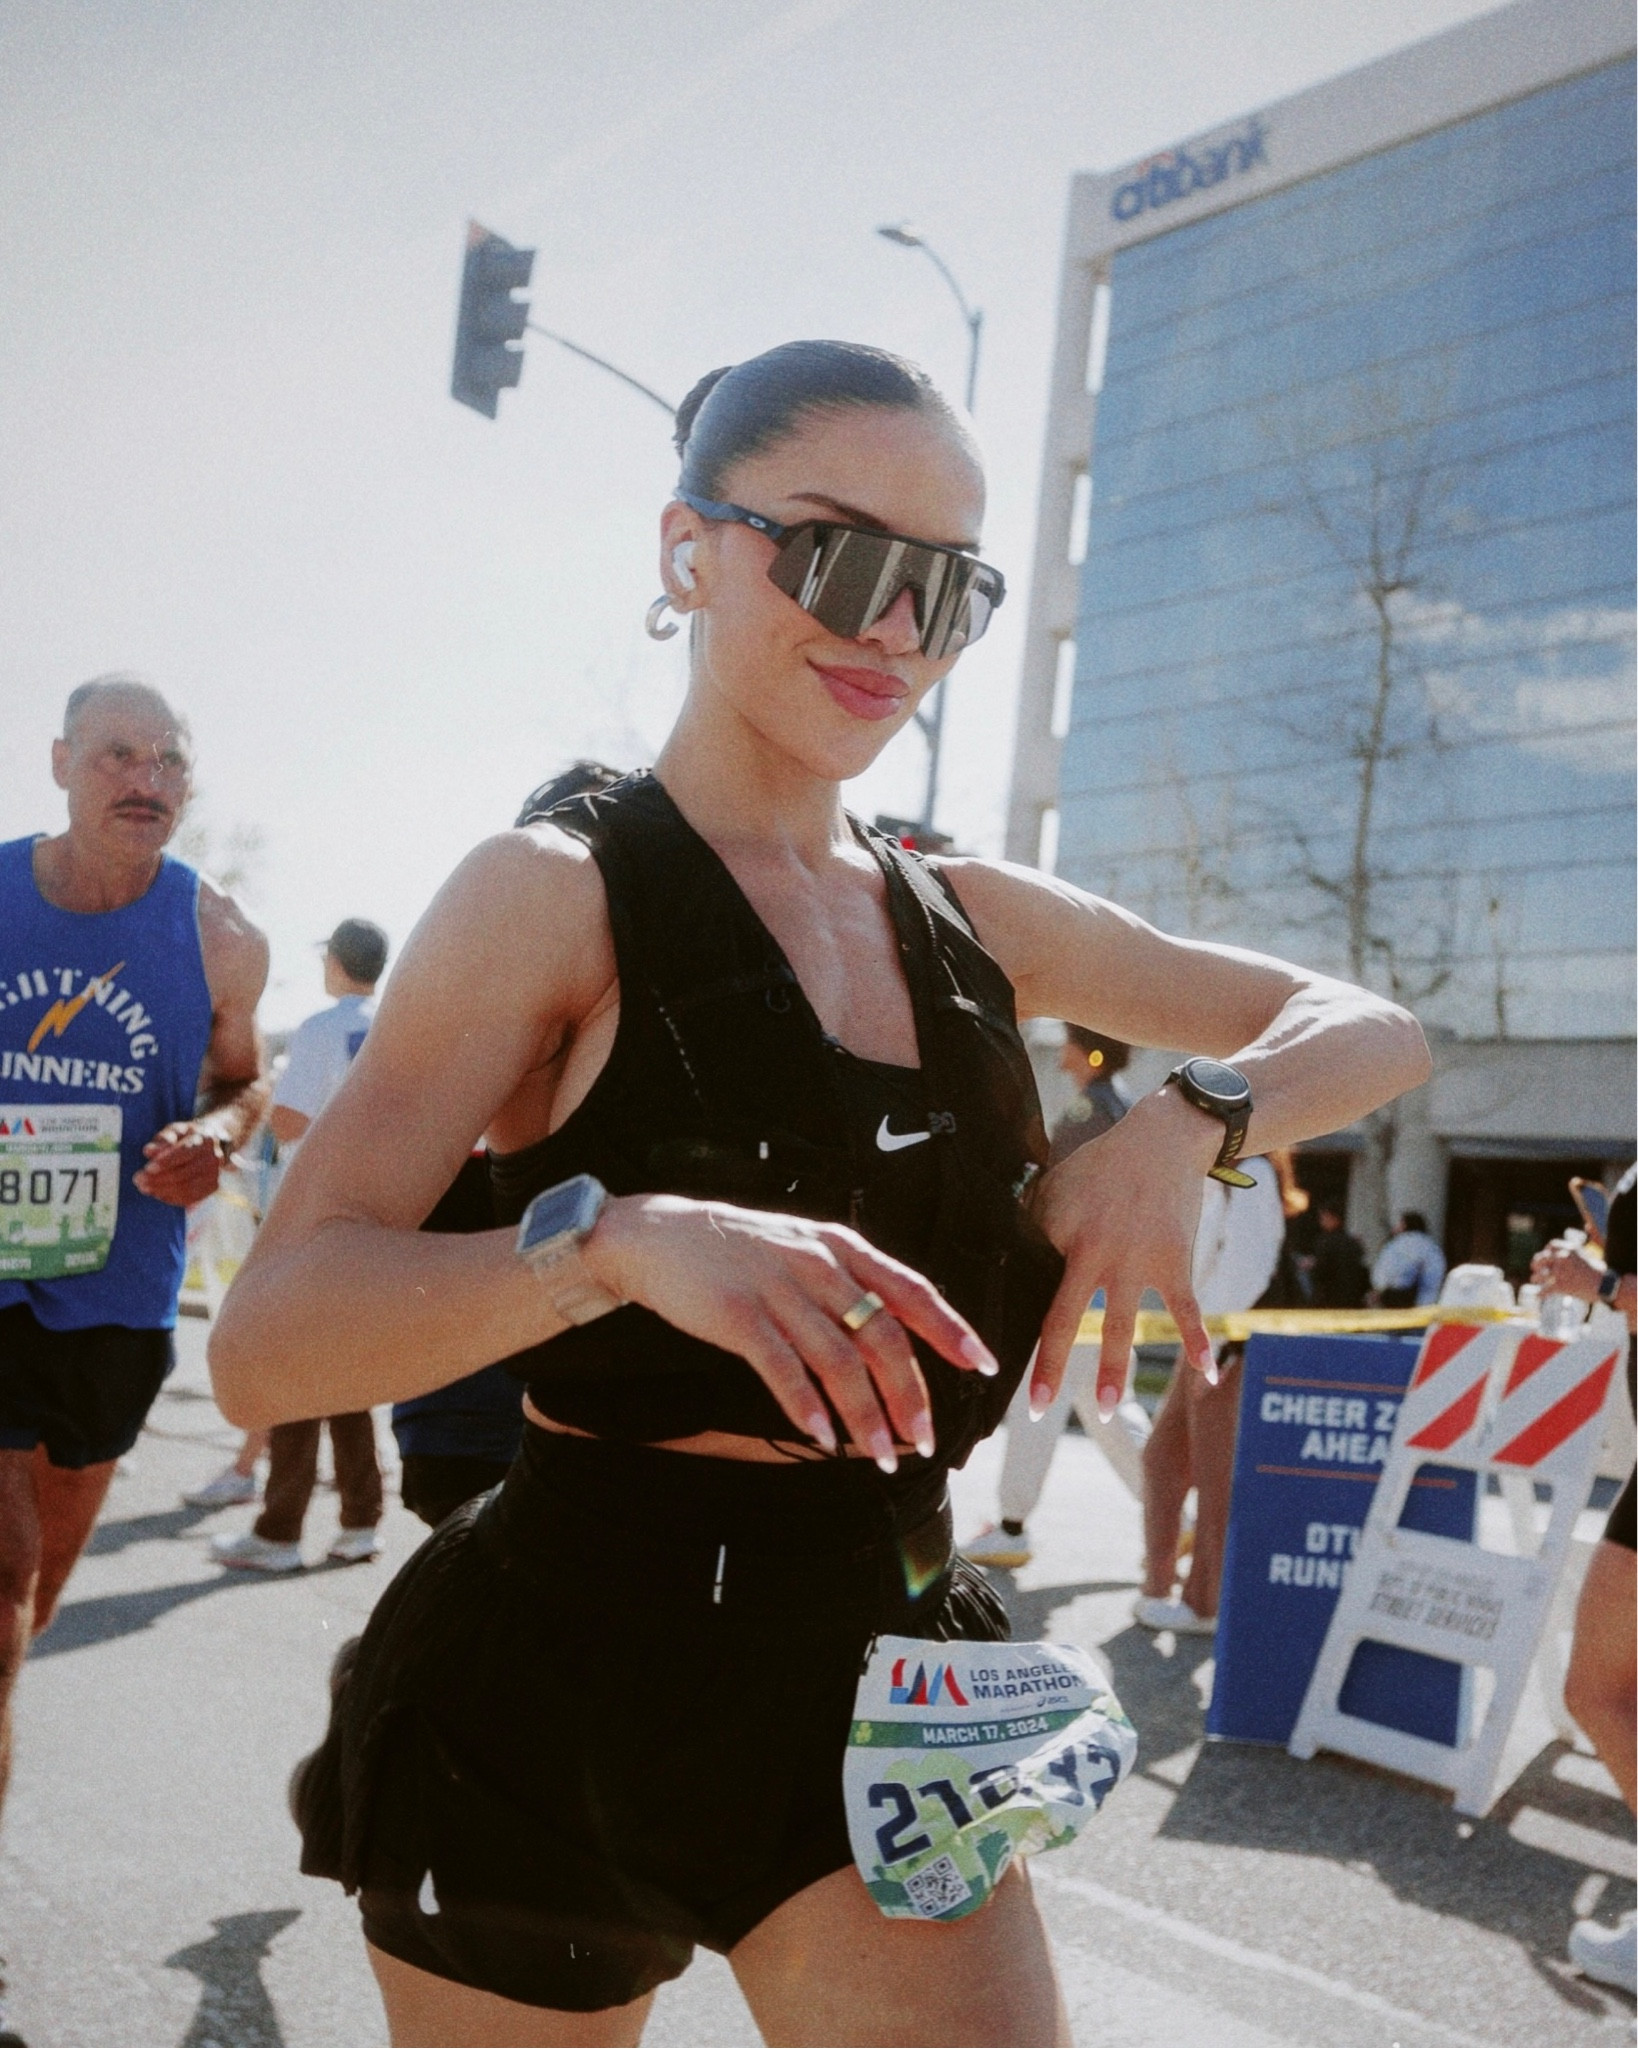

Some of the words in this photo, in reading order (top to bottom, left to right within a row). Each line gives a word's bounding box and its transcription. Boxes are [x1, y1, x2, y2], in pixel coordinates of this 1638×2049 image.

[1261, 1391, 1367, 1430] CHEER
[1301, 1429, 1390, 1465] AHEA
[1268, 1553, 1347, 1588] RUN
[969, 1669, 999, 1682] LOS
[1006, 1663, 1078, 1681] ANGELE
[972, 1675, 1083, 1700] MARATHON
[922, 1725, 979, 1745] MARCH
[981, 1724, 1006, 1741] 17,
[1007, 1716, 1049, 1737] 2024
